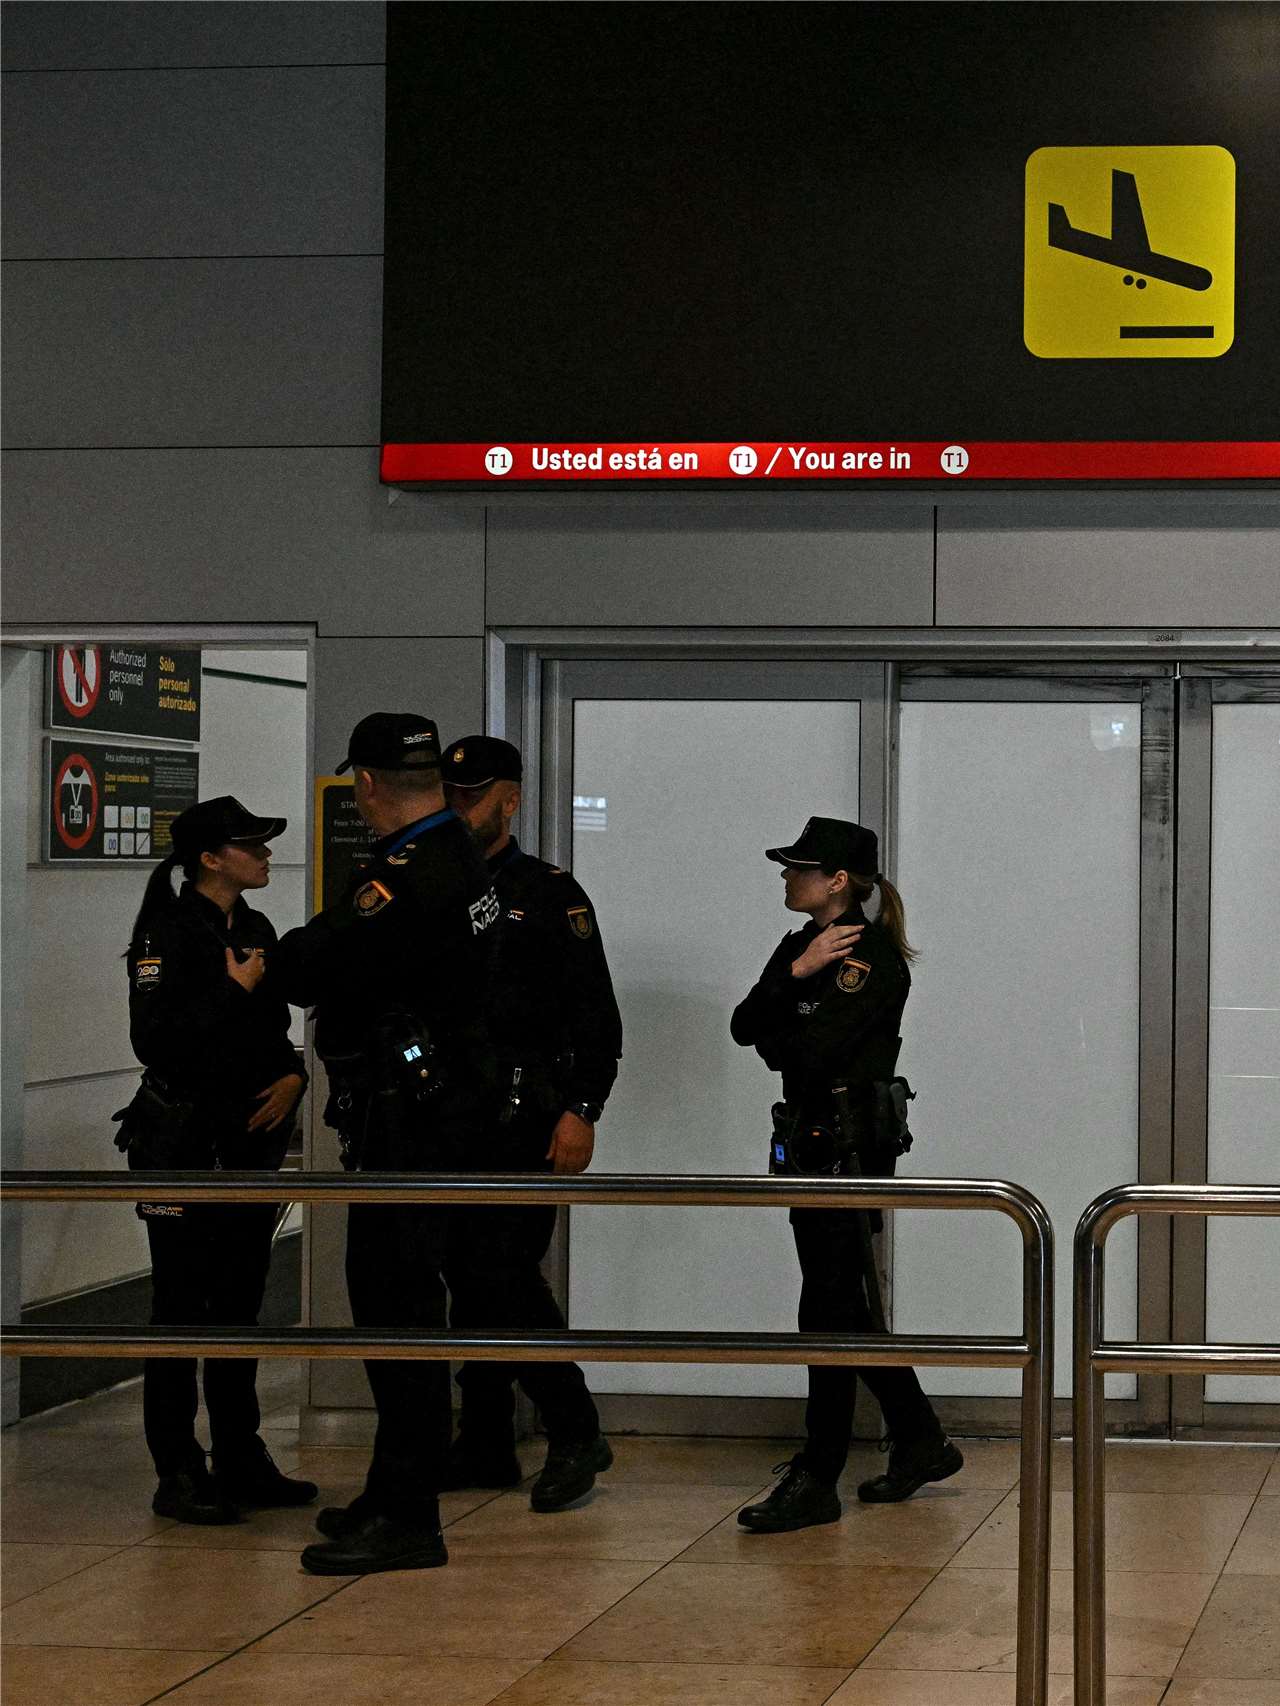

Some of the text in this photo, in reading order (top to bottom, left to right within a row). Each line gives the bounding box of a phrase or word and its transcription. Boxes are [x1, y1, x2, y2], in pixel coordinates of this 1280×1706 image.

[488, 446, 964, 475] T1 Usted está en T1 / You are in T1
[109, 649, 147, 668] Authorized
[109, 670, 144, 686] personnel
[158, 678, 191, 693] personal
[108, 687, 124, 705] only
[158, 696, 197, 712] autorizado
